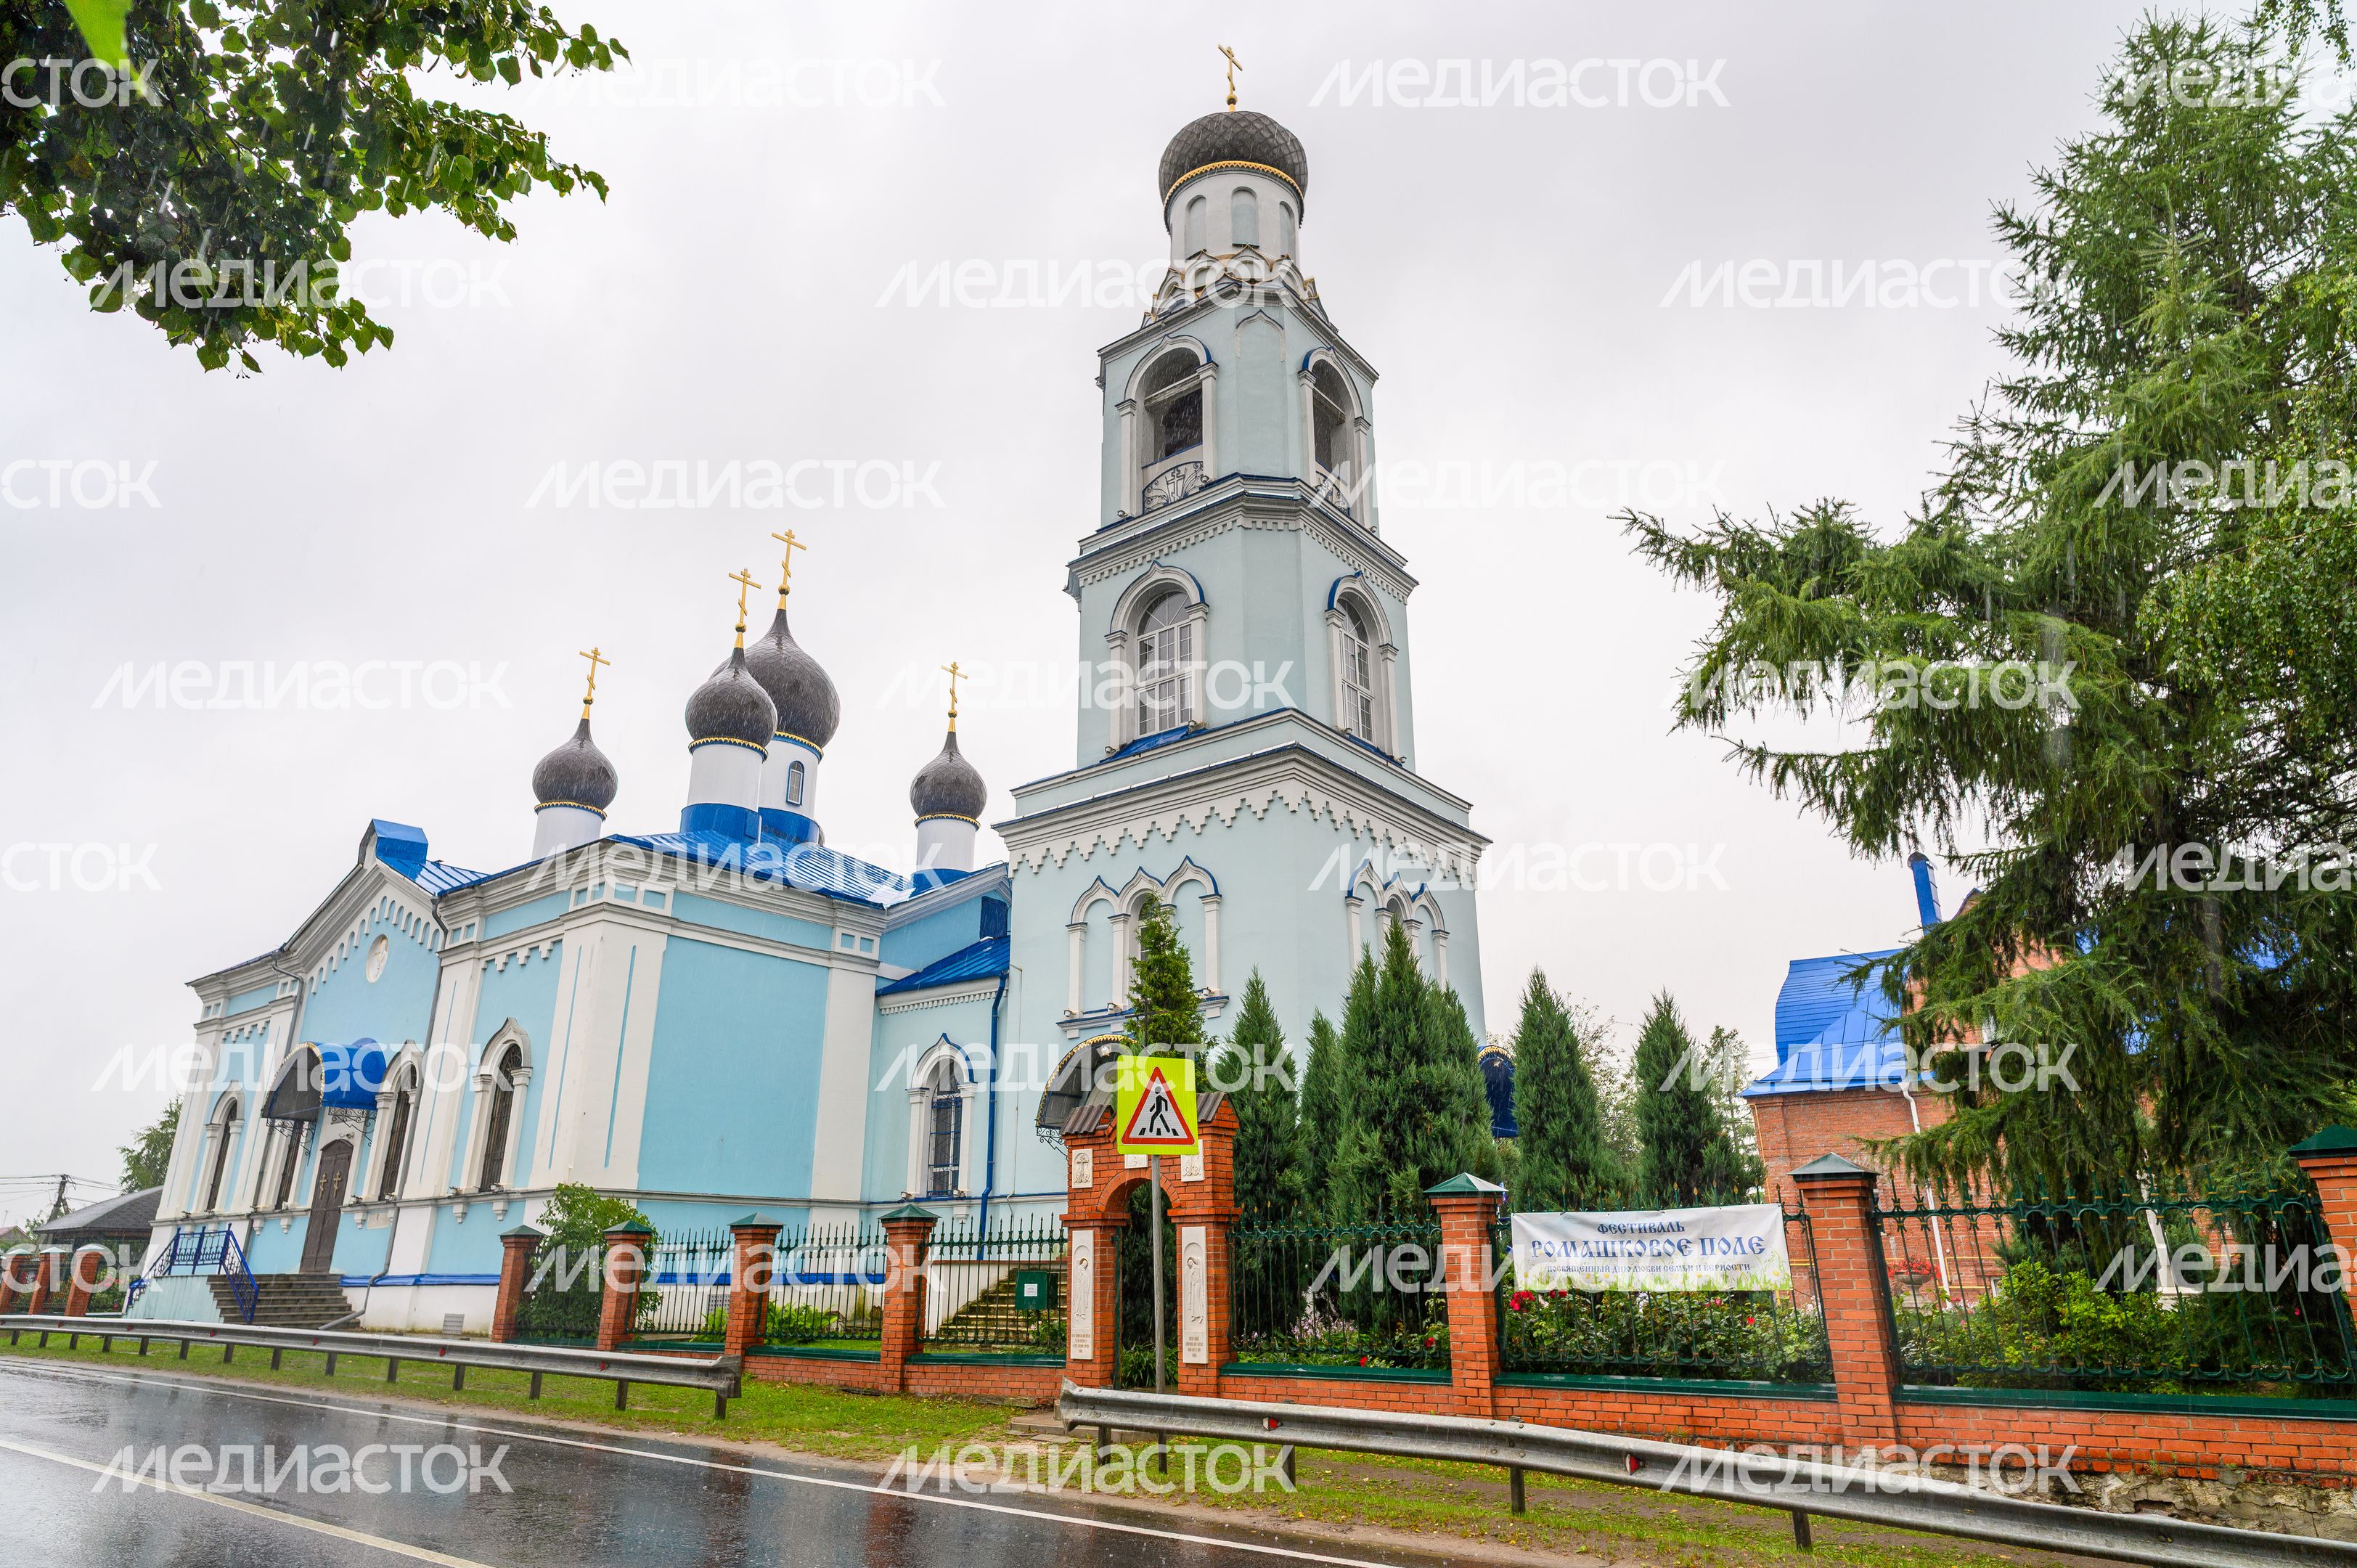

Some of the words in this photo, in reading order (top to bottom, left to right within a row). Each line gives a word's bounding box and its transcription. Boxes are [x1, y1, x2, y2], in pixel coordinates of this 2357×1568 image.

[1597, 1220, 1685, 1234] ФЕСТИВАЛЬ
[1532, 1238, 1693, 1257] РОМАШКОВОЕ
[1699, 1236, 1765, 1256] ПОЛЕ
